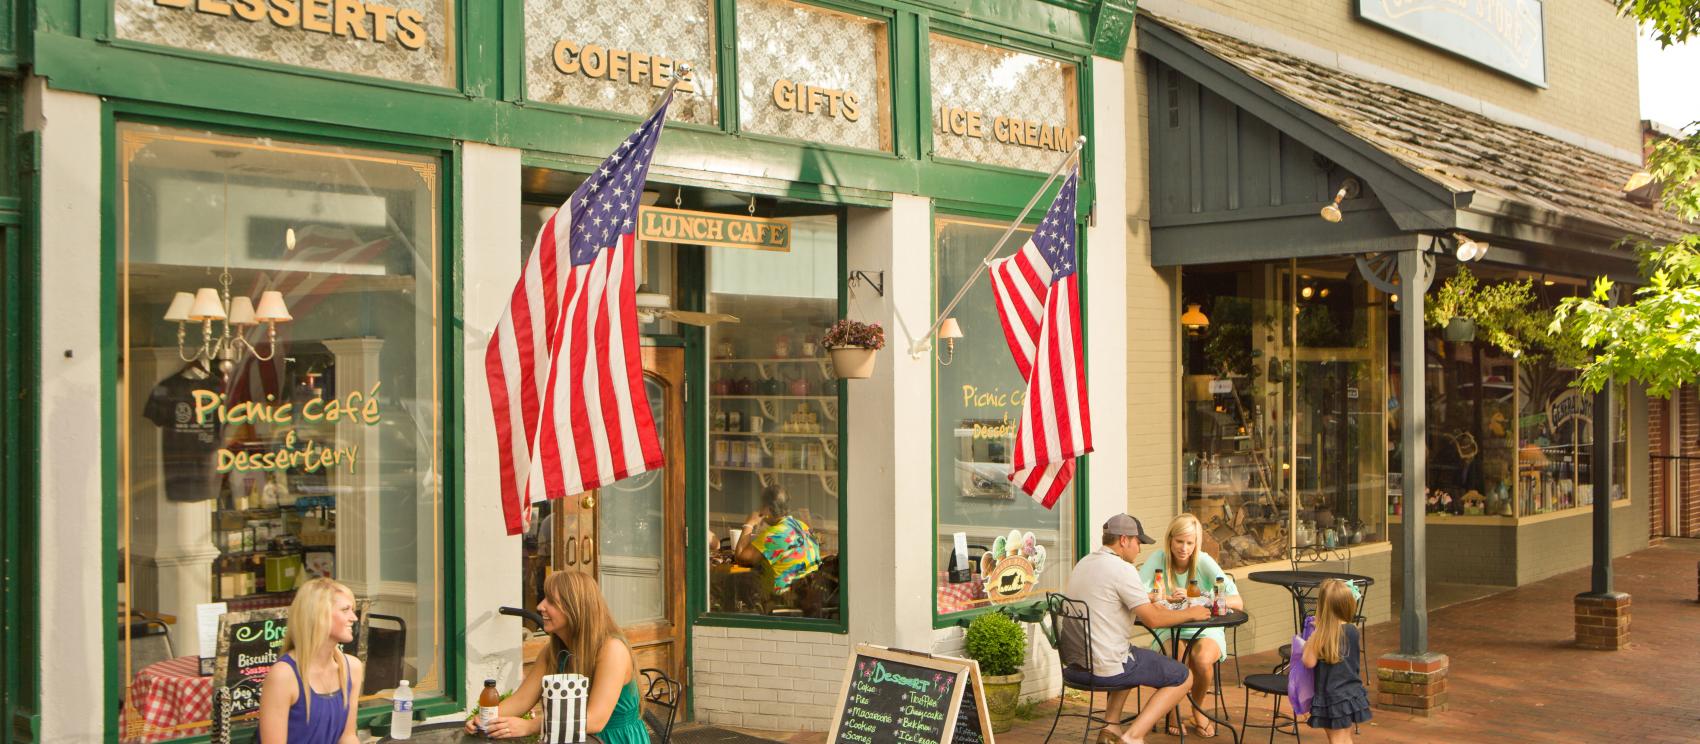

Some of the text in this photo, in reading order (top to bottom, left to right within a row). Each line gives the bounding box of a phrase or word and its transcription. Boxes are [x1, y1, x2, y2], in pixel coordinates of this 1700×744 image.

[553, 40, 694, 93] COFFEE
[773, 79, 860, 122] GIFTS
[941, 104, 1075, 153] ICE CREAM
[646, 213, 723, 241] LUNCH
[192, 390, 293, 426] Picnic
[962, 384, 1007, 408] Picnic
[216, 440, 357, 474] Dessertery
[238, 649, 278, 668] Biscuits
[851, 706, 893, 723] Macaroons
[855, 694, 870, 705] Pies
